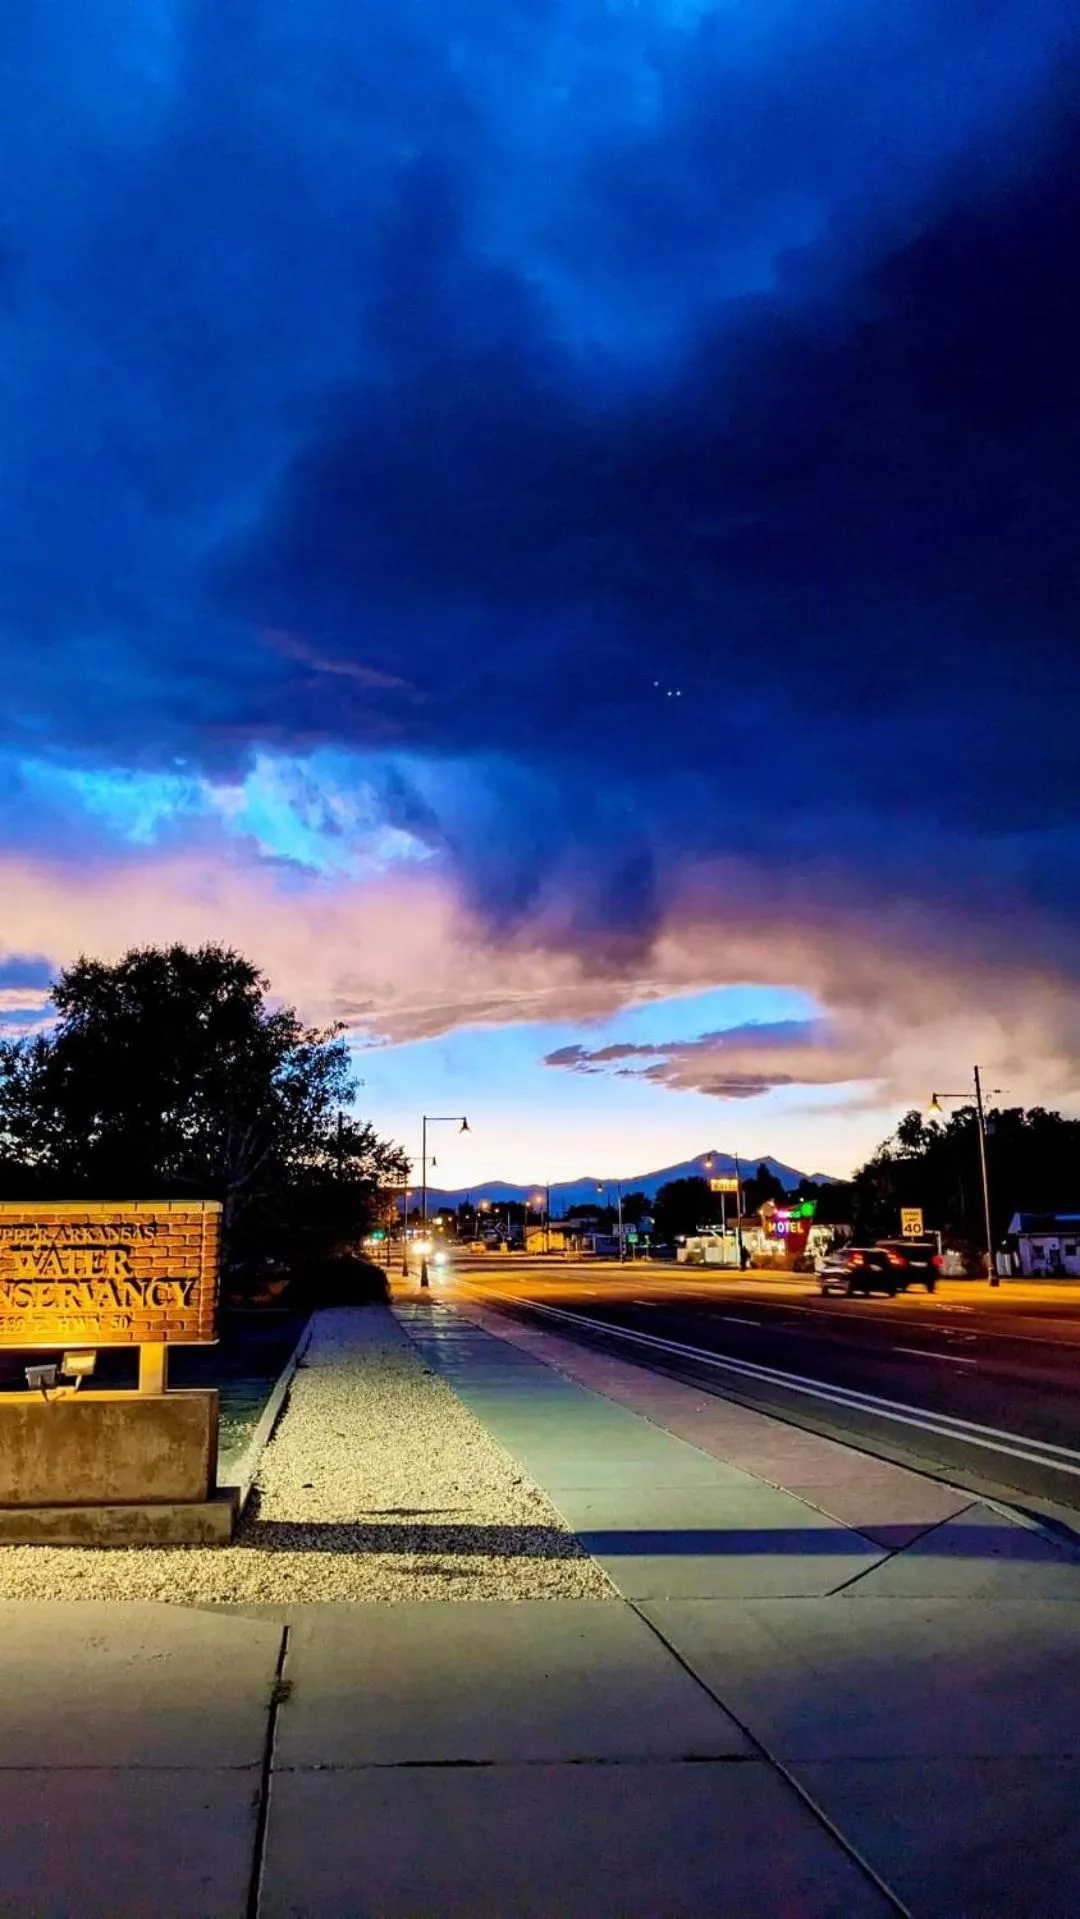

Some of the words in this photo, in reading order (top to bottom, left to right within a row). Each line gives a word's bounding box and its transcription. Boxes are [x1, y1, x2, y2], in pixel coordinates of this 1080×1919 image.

[0, 1227, 46, 1240] PPER
[54, 1226, 155, 1240] ARKANSAS
[768, 1221, 804, 1233] MOTEL
[904, 1223, 921, 1233] 40
[12, 1249, 134, 1277] WATER
